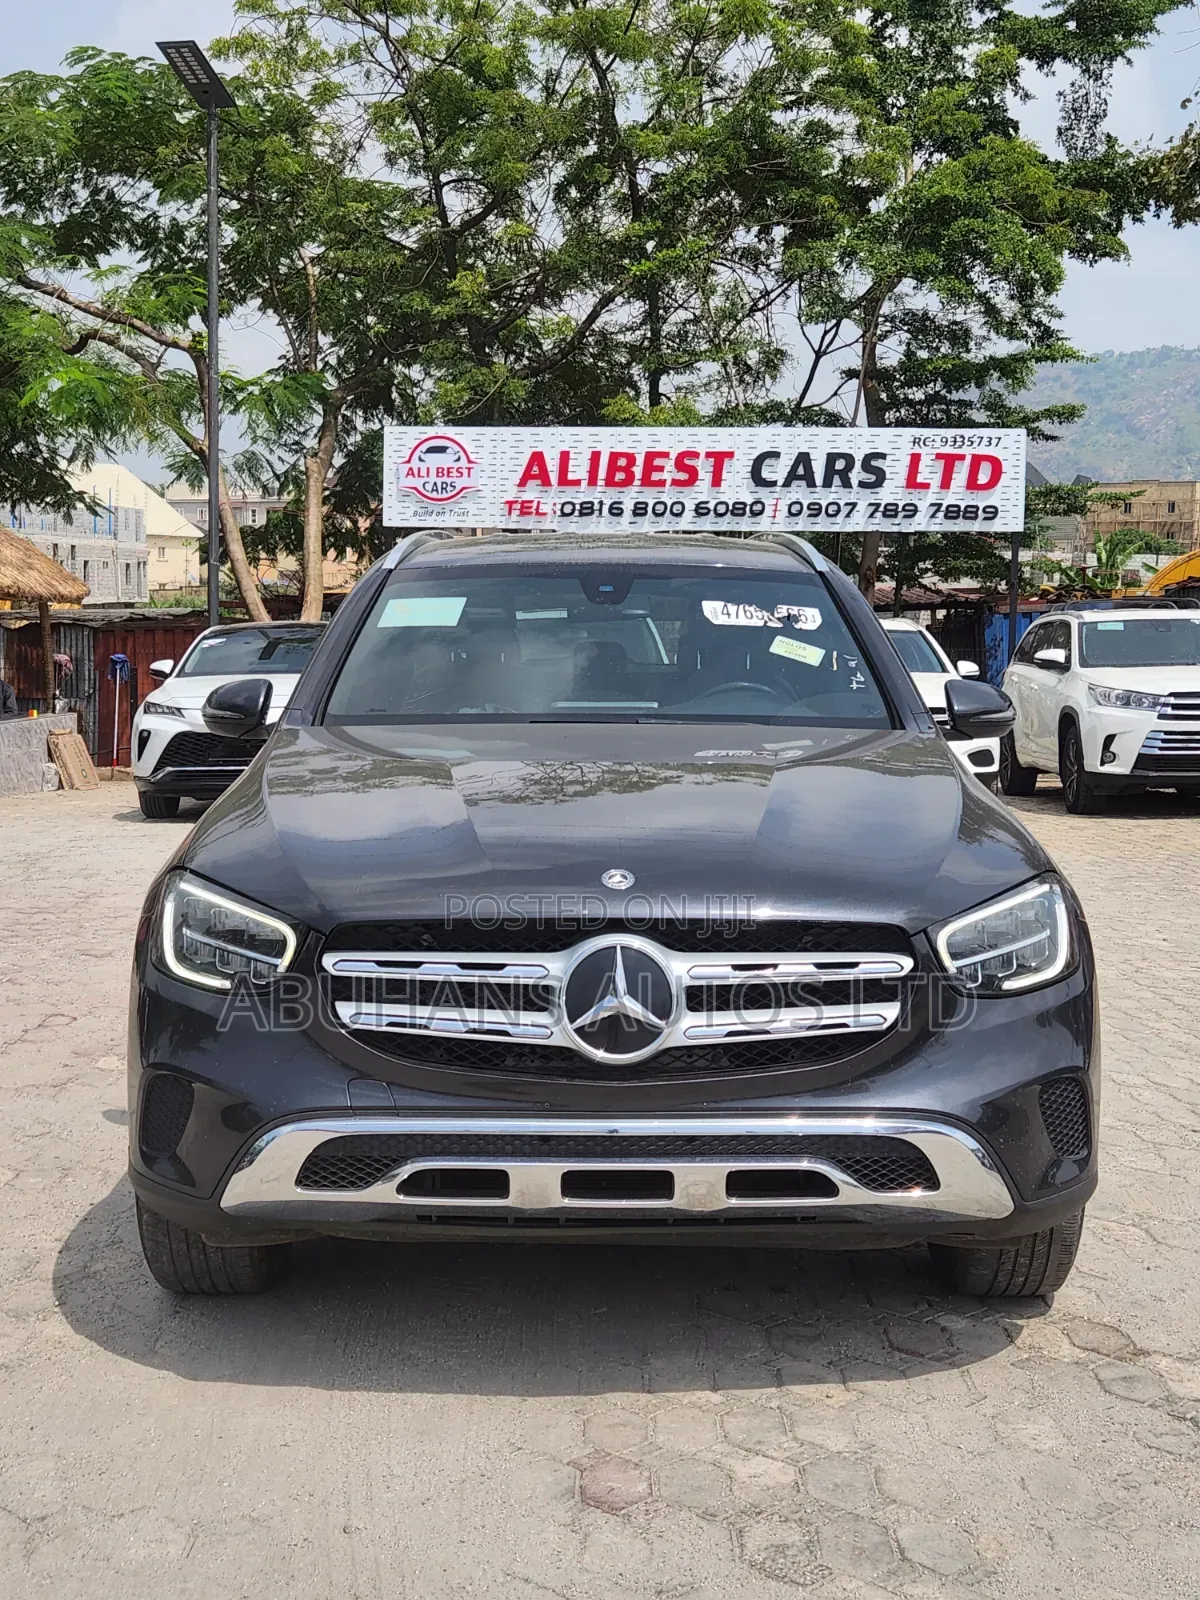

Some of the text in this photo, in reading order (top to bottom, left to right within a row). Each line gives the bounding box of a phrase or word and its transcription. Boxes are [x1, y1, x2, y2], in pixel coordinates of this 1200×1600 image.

[405, 467, 474, 478] ALI BEST
[517, 450, 1003, 491] ALIBEST CARS LTD
[422, 481, 456, 495] CARS
[412, 509, 434, 518] Build
[448, 509, 470, 518] Trust
[503, 500, 557, 517] TEL:
[560, 500, 624, 517] 0816
[632, 501, 686, 517] 800
[694, 500, 765, 518] 6080
[787, 501, 858, 518] 0907
[867, 502, 918, 519] 789
[929, 504, 999, 521] 7889
